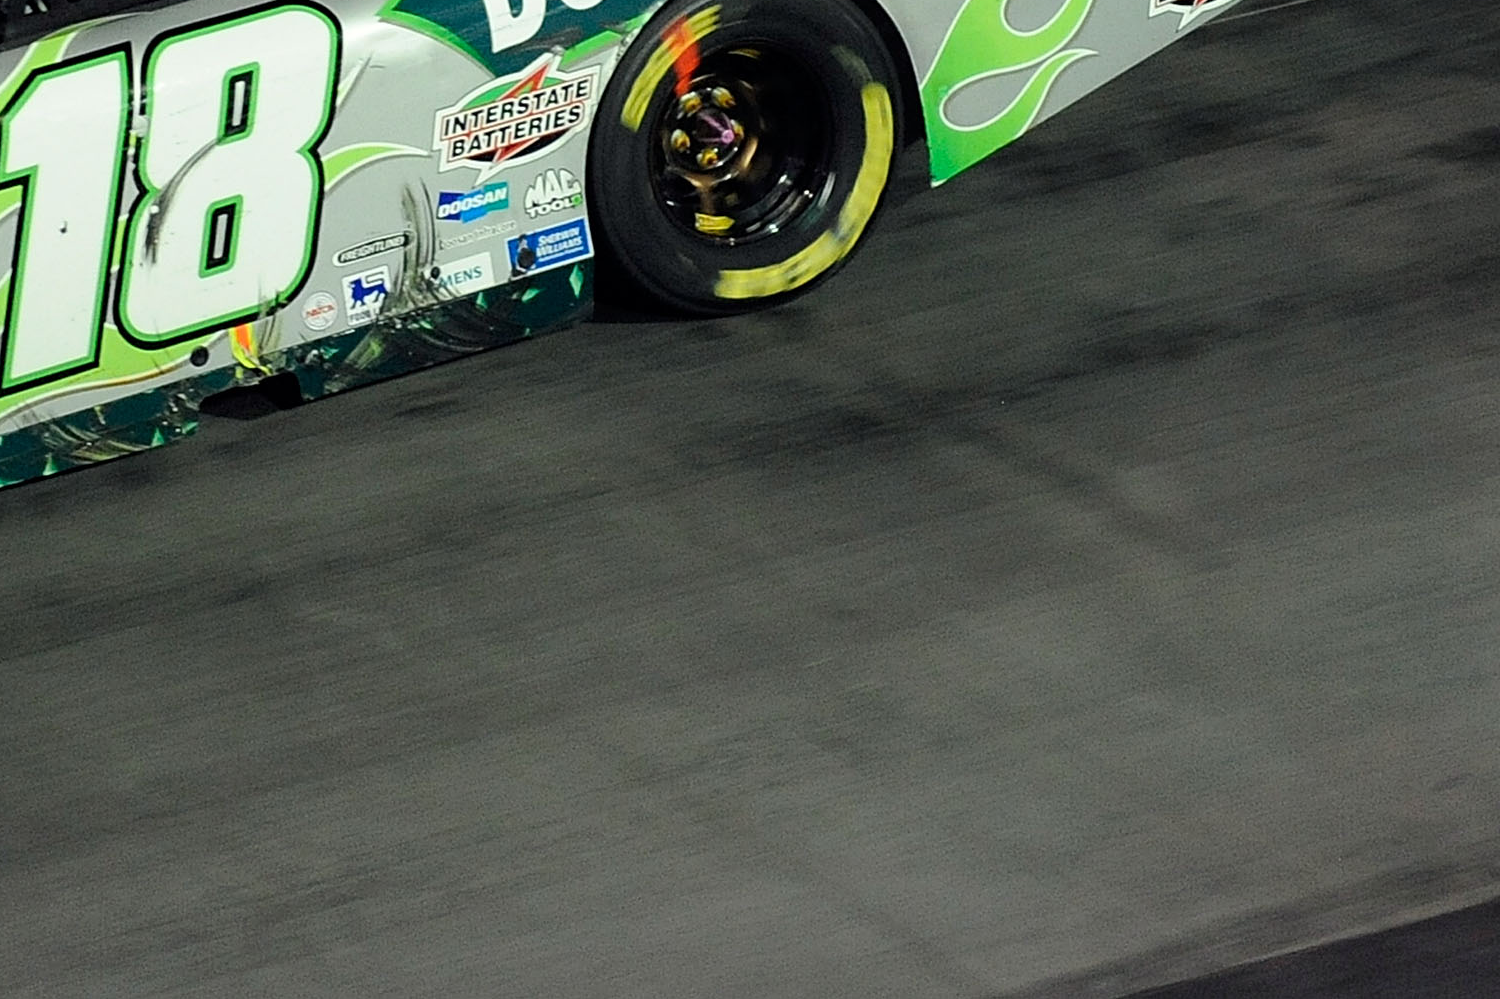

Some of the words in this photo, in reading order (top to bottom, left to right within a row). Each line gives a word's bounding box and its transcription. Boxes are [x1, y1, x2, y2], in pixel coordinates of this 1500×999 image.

[443, 78, 590, 137] INTERSTATE
[451, 104, 583, 159] BATTERIES
[437, 188, 509, 220] DOOSAN
[525, 168, 583, 210] MAC
[525, 193, 583, 220] TOOL
[437, 266, 483, 289] MENS
